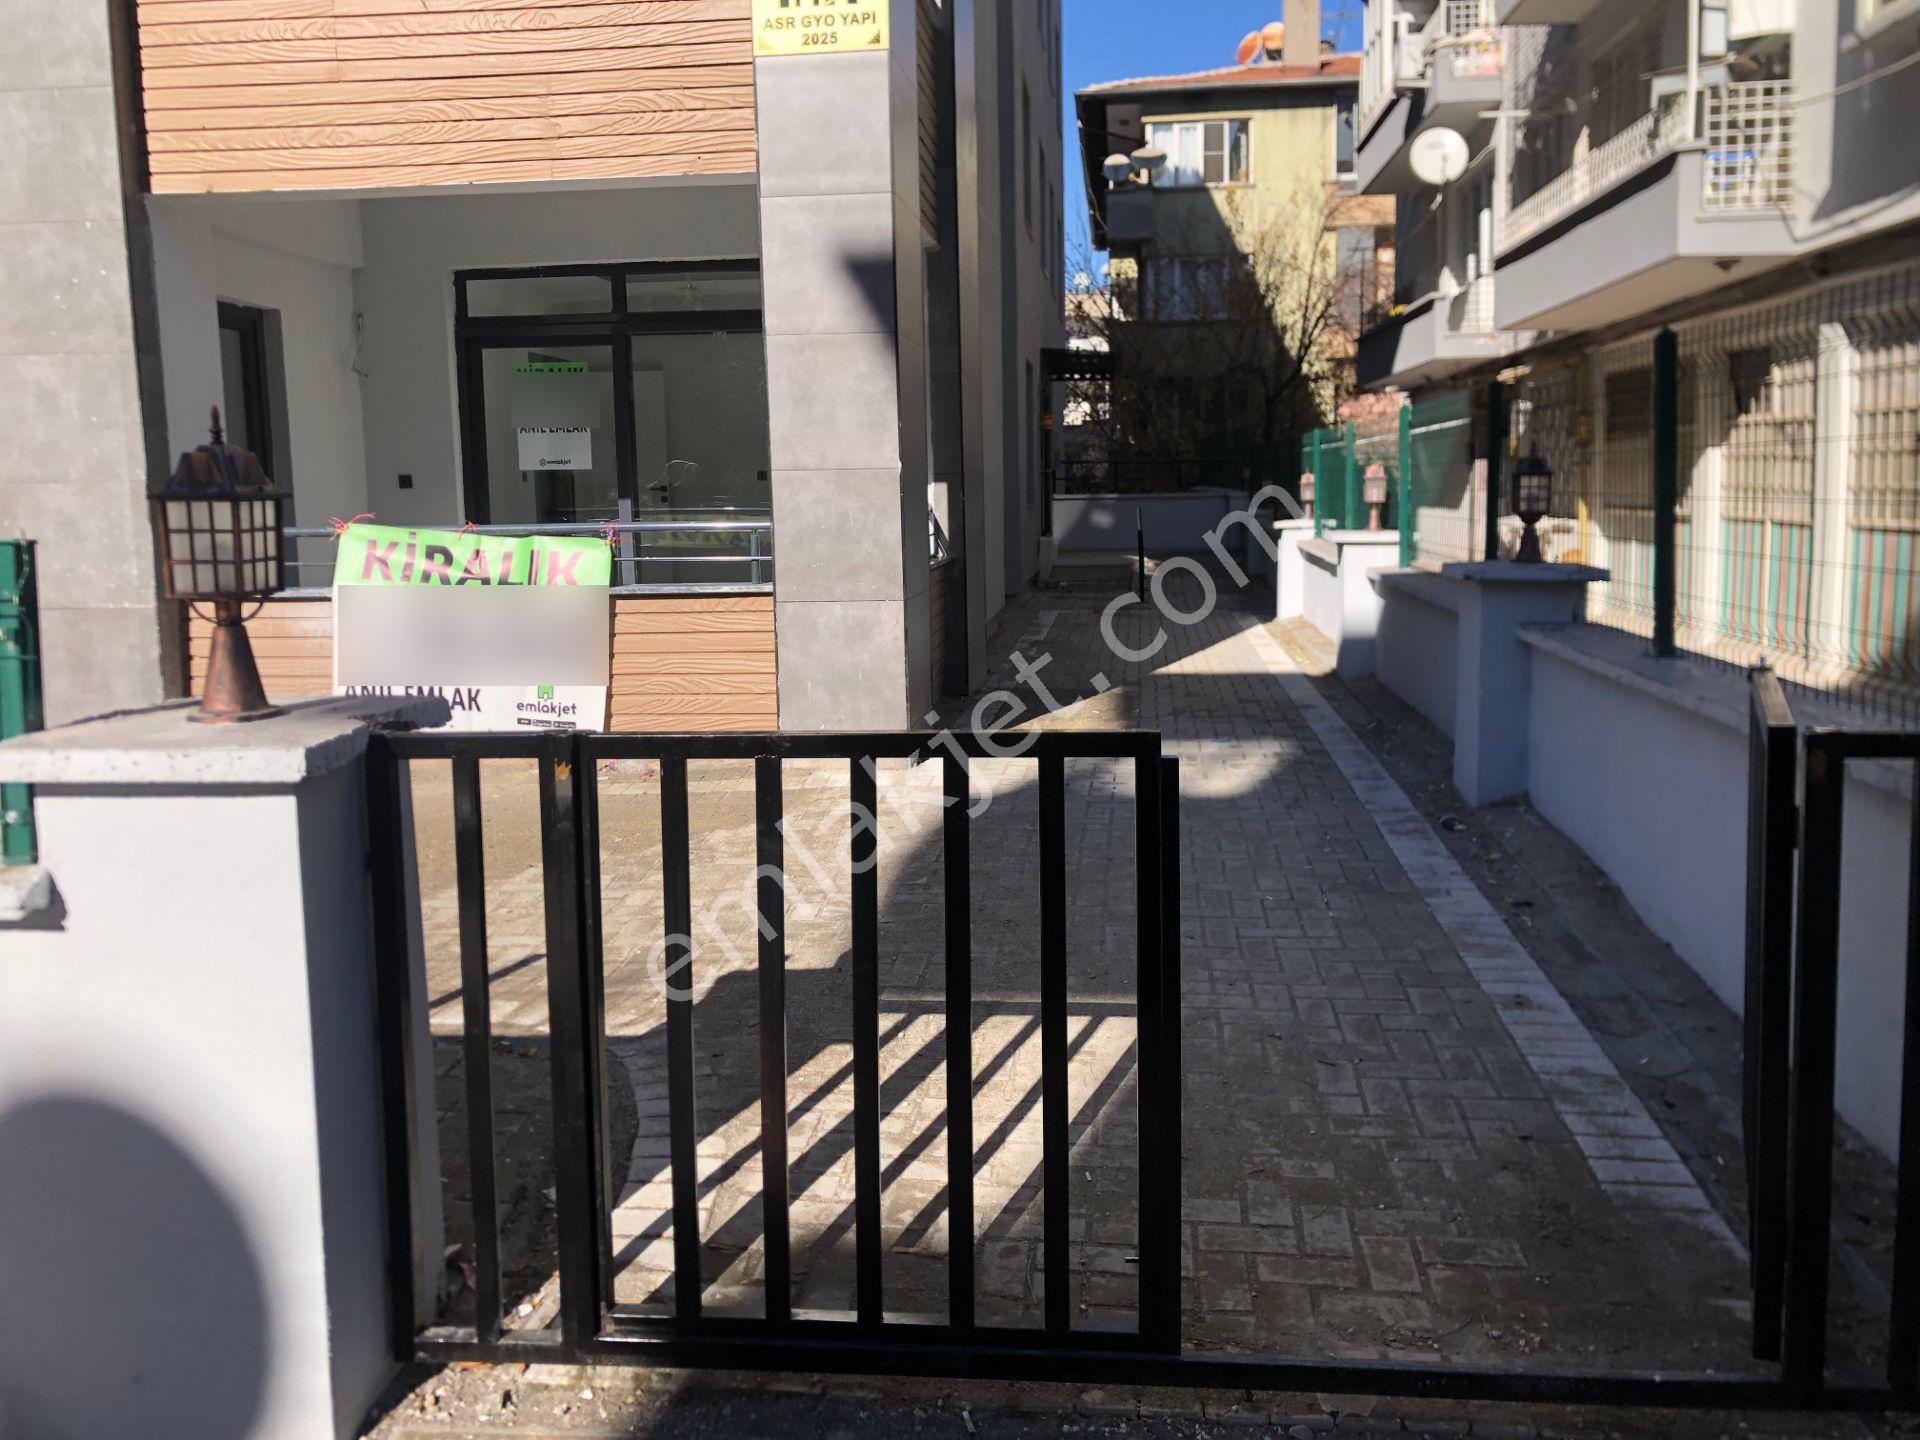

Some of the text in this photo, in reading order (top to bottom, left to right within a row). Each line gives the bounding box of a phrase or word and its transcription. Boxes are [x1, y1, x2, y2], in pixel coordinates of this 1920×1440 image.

[764, 12, 876, 30] ASR GYO YAPI
[803, 32, 838, 46] 2025
[361, 532, 583, 586] KİRALIK
[516, 701, 577, 718] emlakjet
